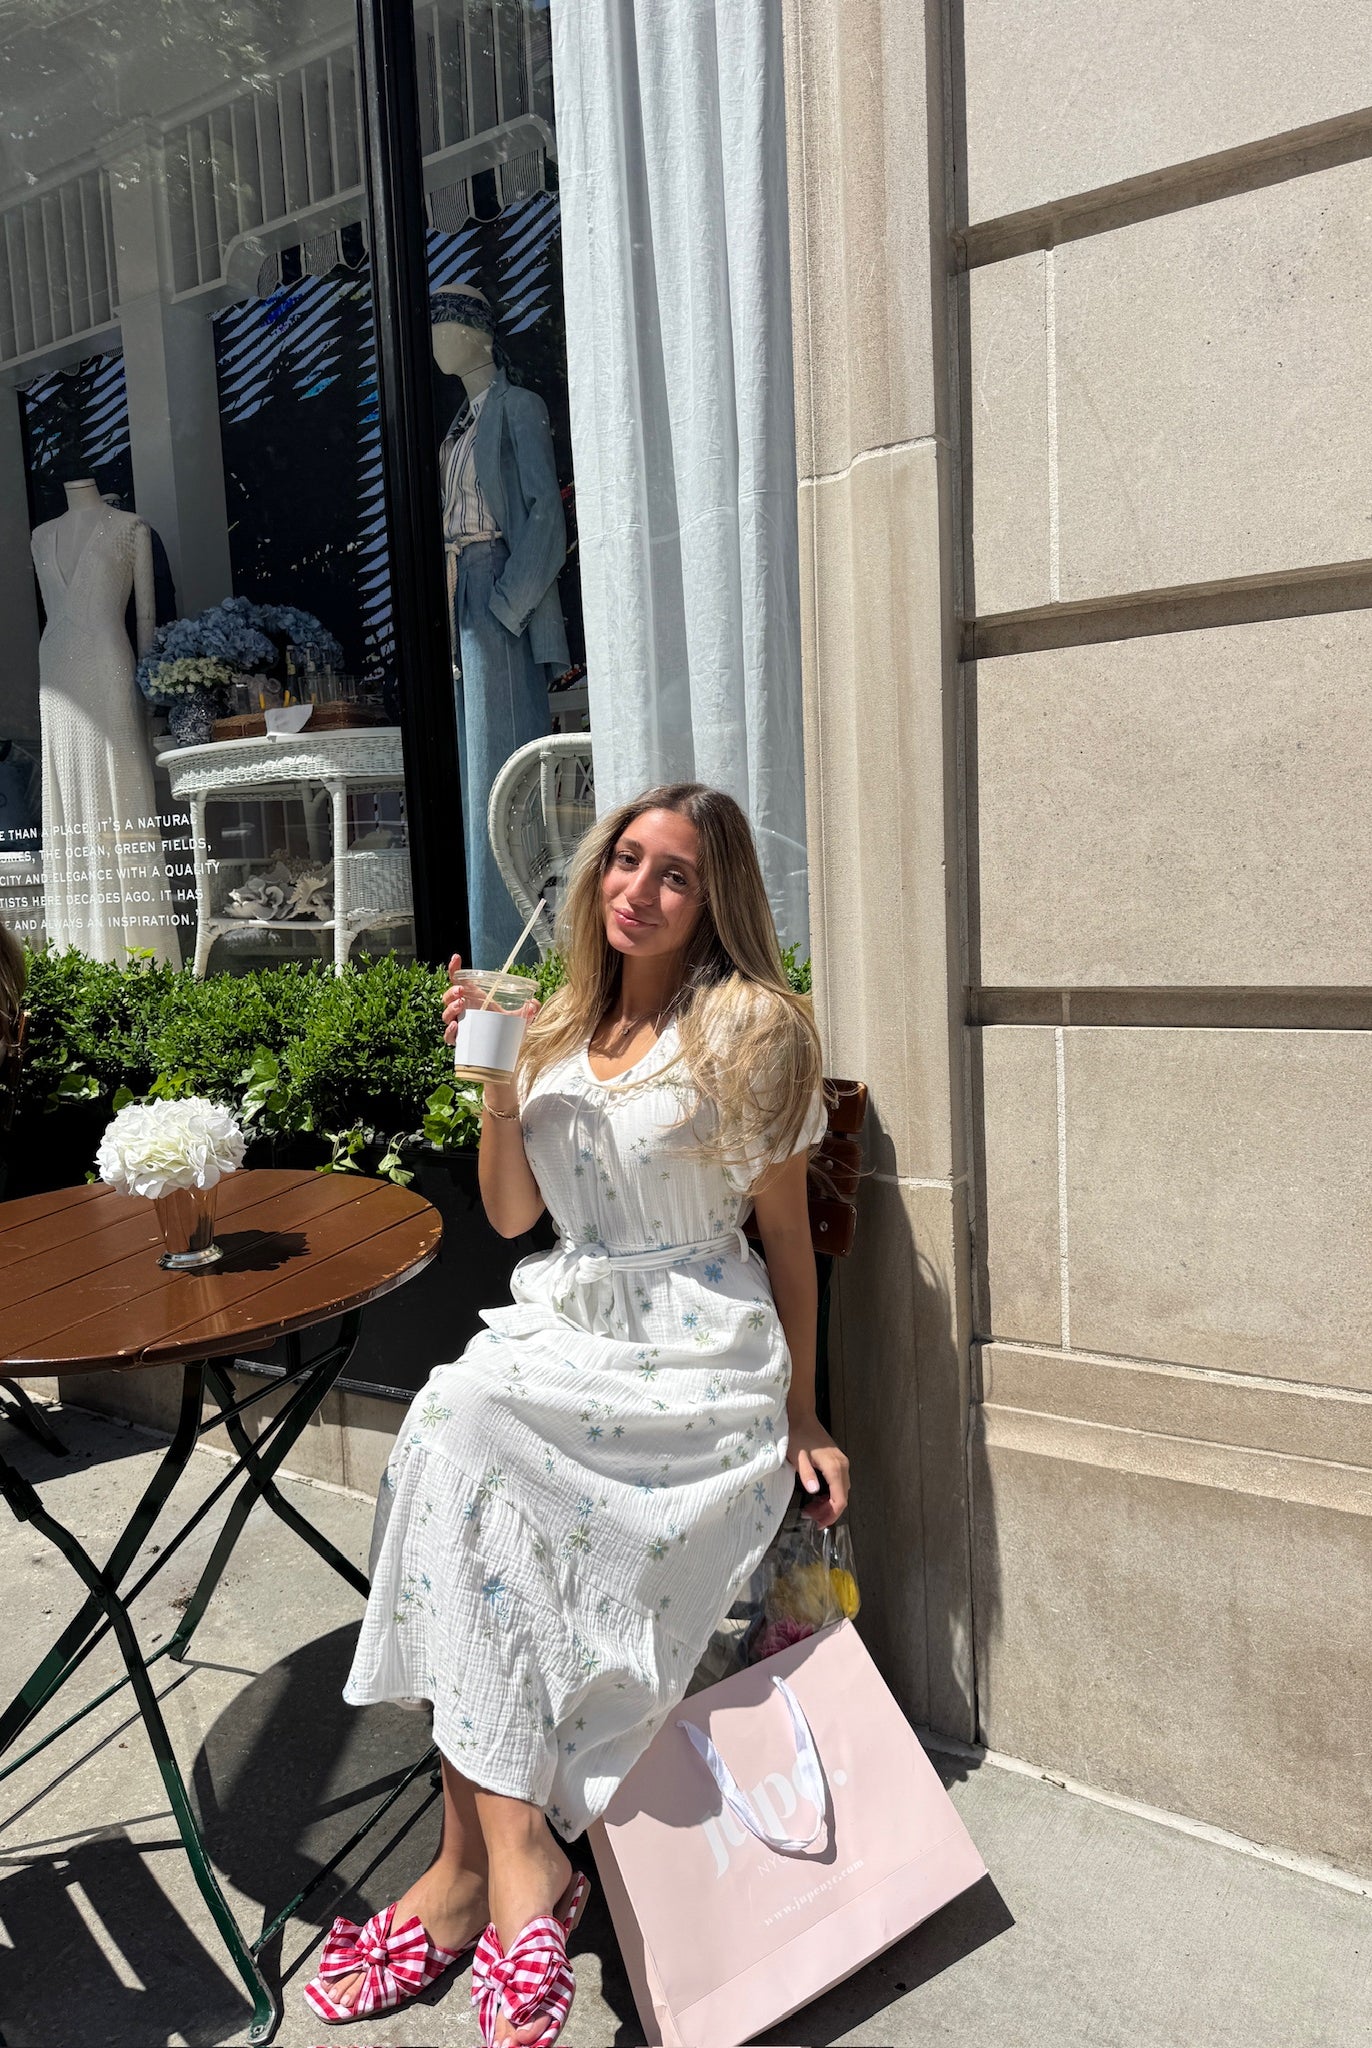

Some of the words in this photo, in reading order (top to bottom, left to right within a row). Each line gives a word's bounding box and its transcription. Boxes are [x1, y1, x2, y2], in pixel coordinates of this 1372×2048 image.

[8, 827, 38, 841] THAN
[41, 826, 50, 838] A
[97, 817, 121, 832] IT'S
[125, 819, 134, 830] A
[138, 813, 198, 829] NATURAL
[39, 849, 61, 861] THE
[65, 845, 111, 859] OCEAN,
[115, 841, 156, 855] GREEN
[161, 838, 212, 852] FIELDS,
[25, 873, 48, 885] AND
[53, 869, 113, 883] ELEGANCE
[116, 866, 147, 879] WITH
[151, 866, 161, 877] A
[164, 861, 221, 878] QUALITY
[32, 895, 63, 908] HERE
[66, 892, 121, 906] DECADES
[124, 890, 156, 903] AGO.
[160, 889, 172, 902] IT
[177, 888, 204, 901] HAS
[14, 918, 38, 931] AND
[40, 917, 84, 930] ALWAYS
[87, 917, 104, 929] AN
